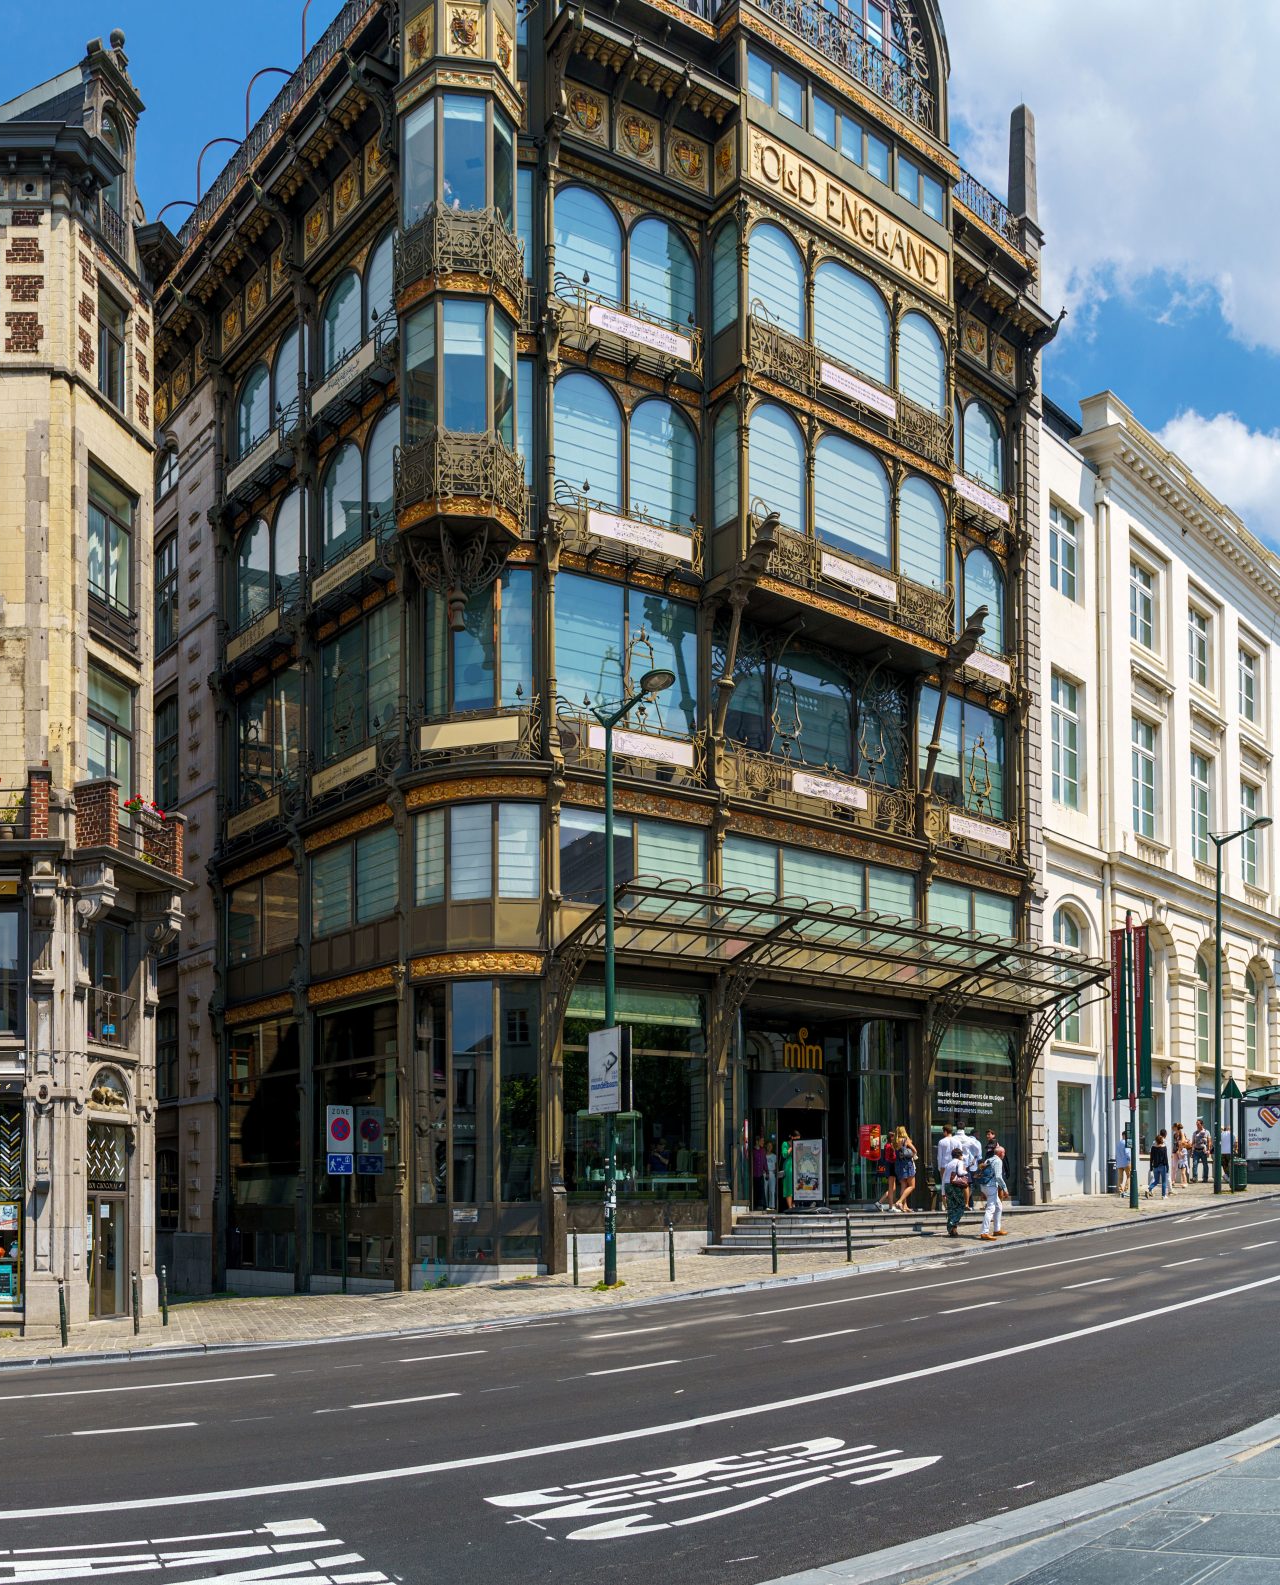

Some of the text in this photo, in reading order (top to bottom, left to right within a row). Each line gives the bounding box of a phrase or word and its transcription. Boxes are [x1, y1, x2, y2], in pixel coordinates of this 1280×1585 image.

[761, 146, 939, 285] OLD ENGLAND
[784, 1027, 822, 1069] mim
[482, 1436, 943, 1541] BUS
